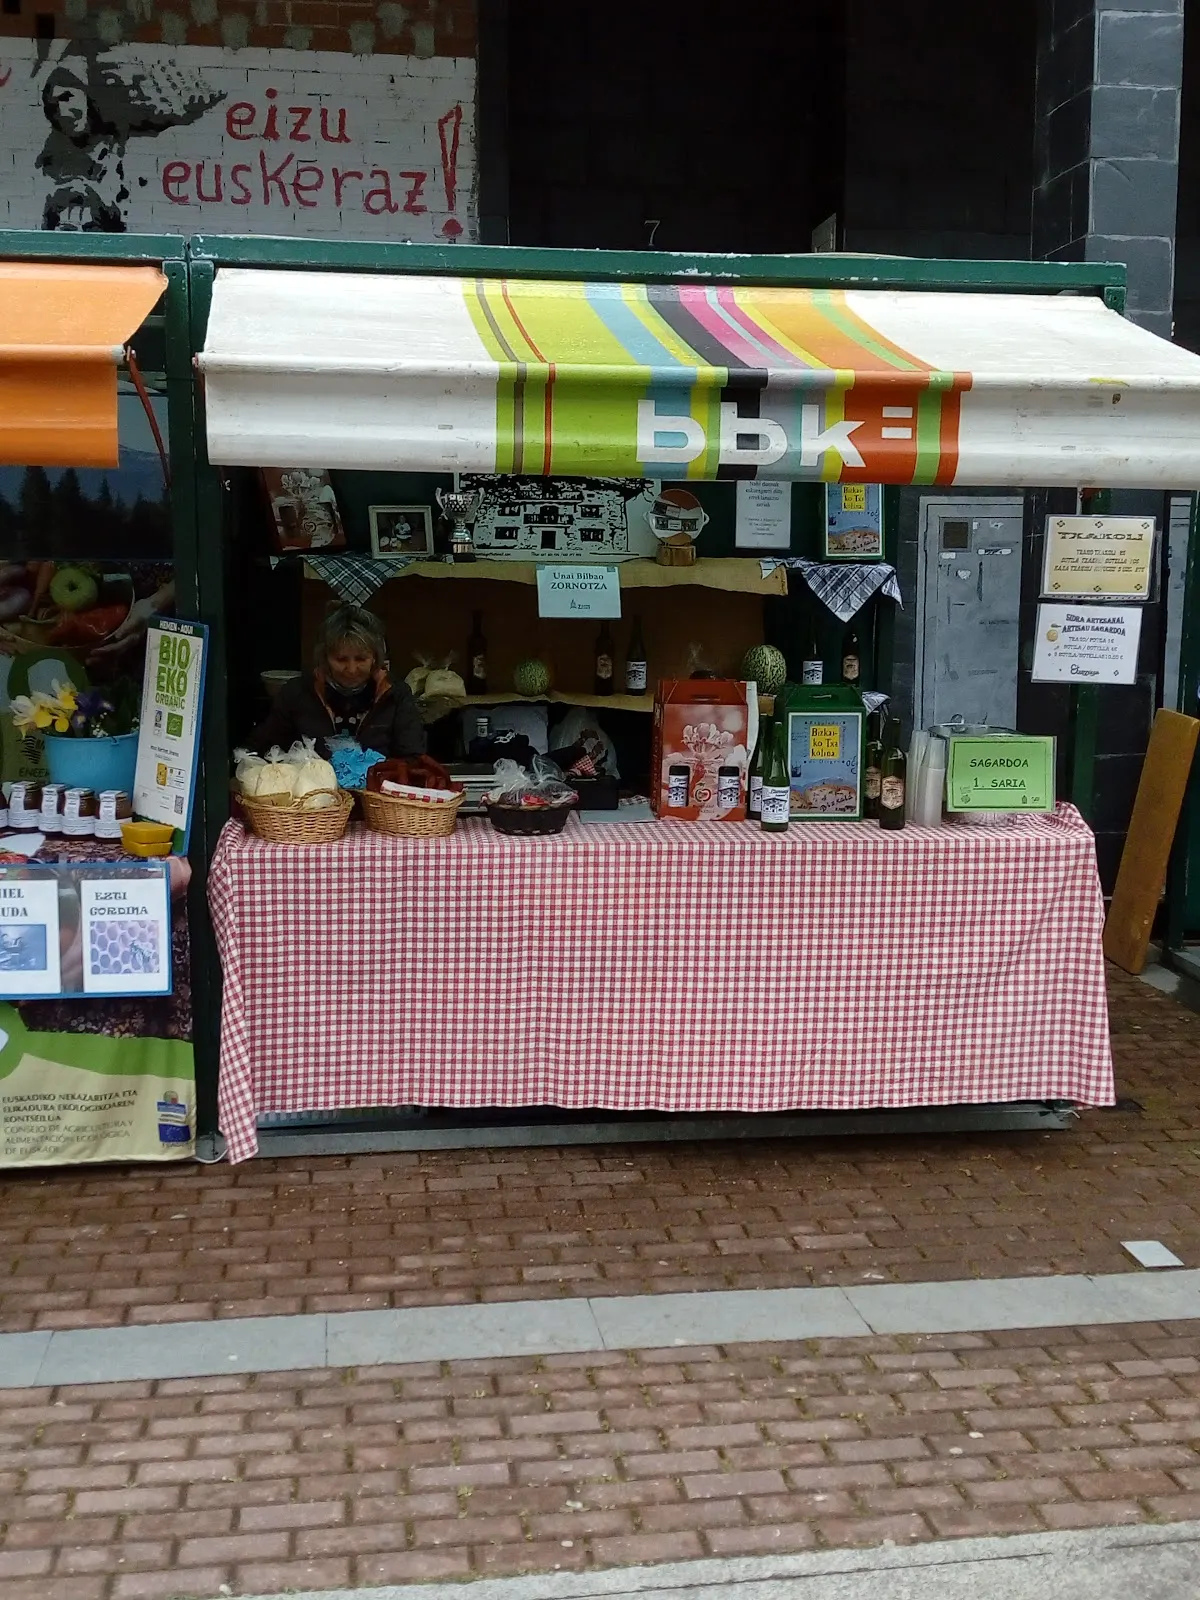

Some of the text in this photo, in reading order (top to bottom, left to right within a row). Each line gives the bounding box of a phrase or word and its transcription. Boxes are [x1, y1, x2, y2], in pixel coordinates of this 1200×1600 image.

[226, 87, 351, 143] eizu
[644, 220, 660, 246] 7
[553, 572, 604, 580] Unai Bilbao
[550, 582, 608, 590] ZORNOTZA
[1066, 613, 1125, 624] SIDRA ARTESANAL
[1061, 625, 1126, 636] ARTISAU SAGARDOA
[158, 634, 190, 670] BIO
[156, 666, 187, 697] EKO
[155, 692, 185, 710] ORGANIC
[969, 758, 1029, 768] SAGARDOA
[990, 778, 1026, 788] SARIA
[0, 888, 24, 899] IEL
[95, 891, 128, 901] EZTI
[0, 906, 28, 917] UDA
[89, 906, 149, 916] GORDINA
[2, 1089, 138, 1103] EUSKADIKO NEKAZARITZA ETA
[3, 1100, 135, 1113] ELIKADURA EKOLOGIKOAREN
[4, 1125, 45, 1135] CONSEJO
[5, 1147, 17, 1155] DE
